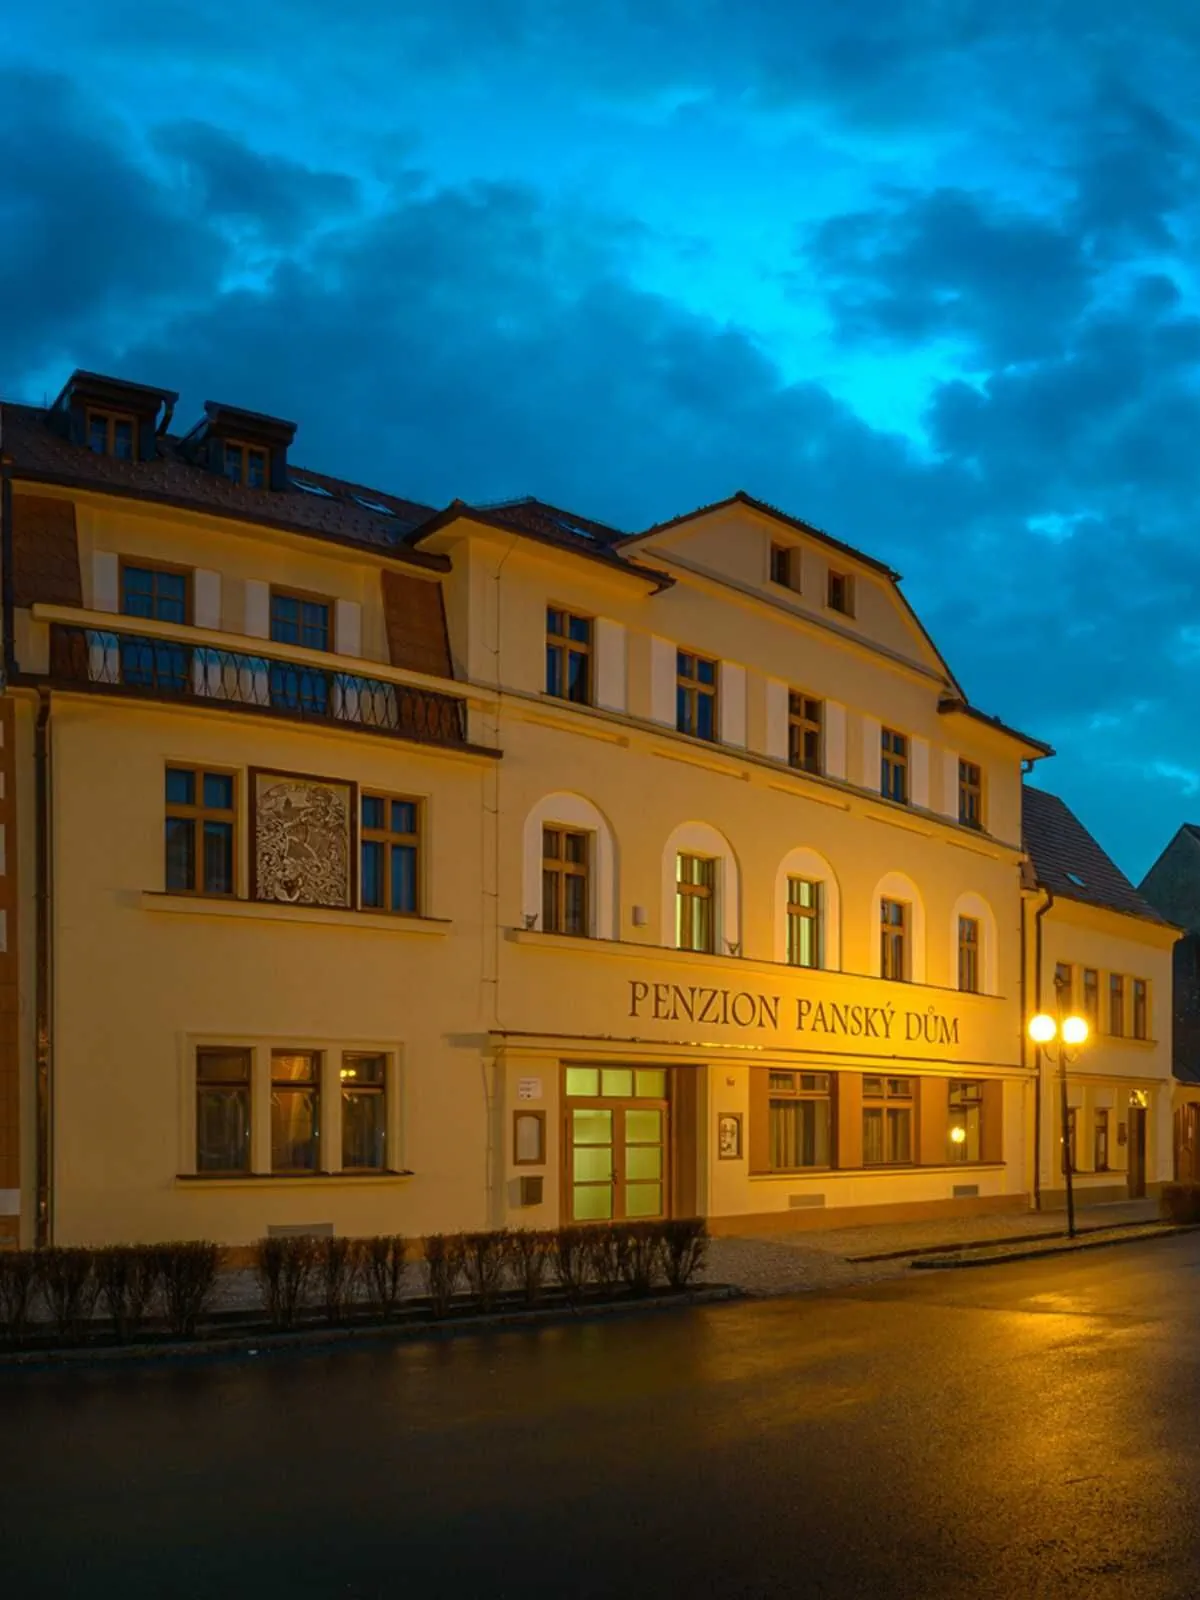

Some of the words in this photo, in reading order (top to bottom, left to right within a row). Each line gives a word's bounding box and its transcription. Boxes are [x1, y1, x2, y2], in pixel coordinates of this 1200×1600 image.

[628, 980, 780, 1029] PENZION
[796, 998, 896, 1039] PANSKÝ
[905, 1004, 959, 1045] DŮM
